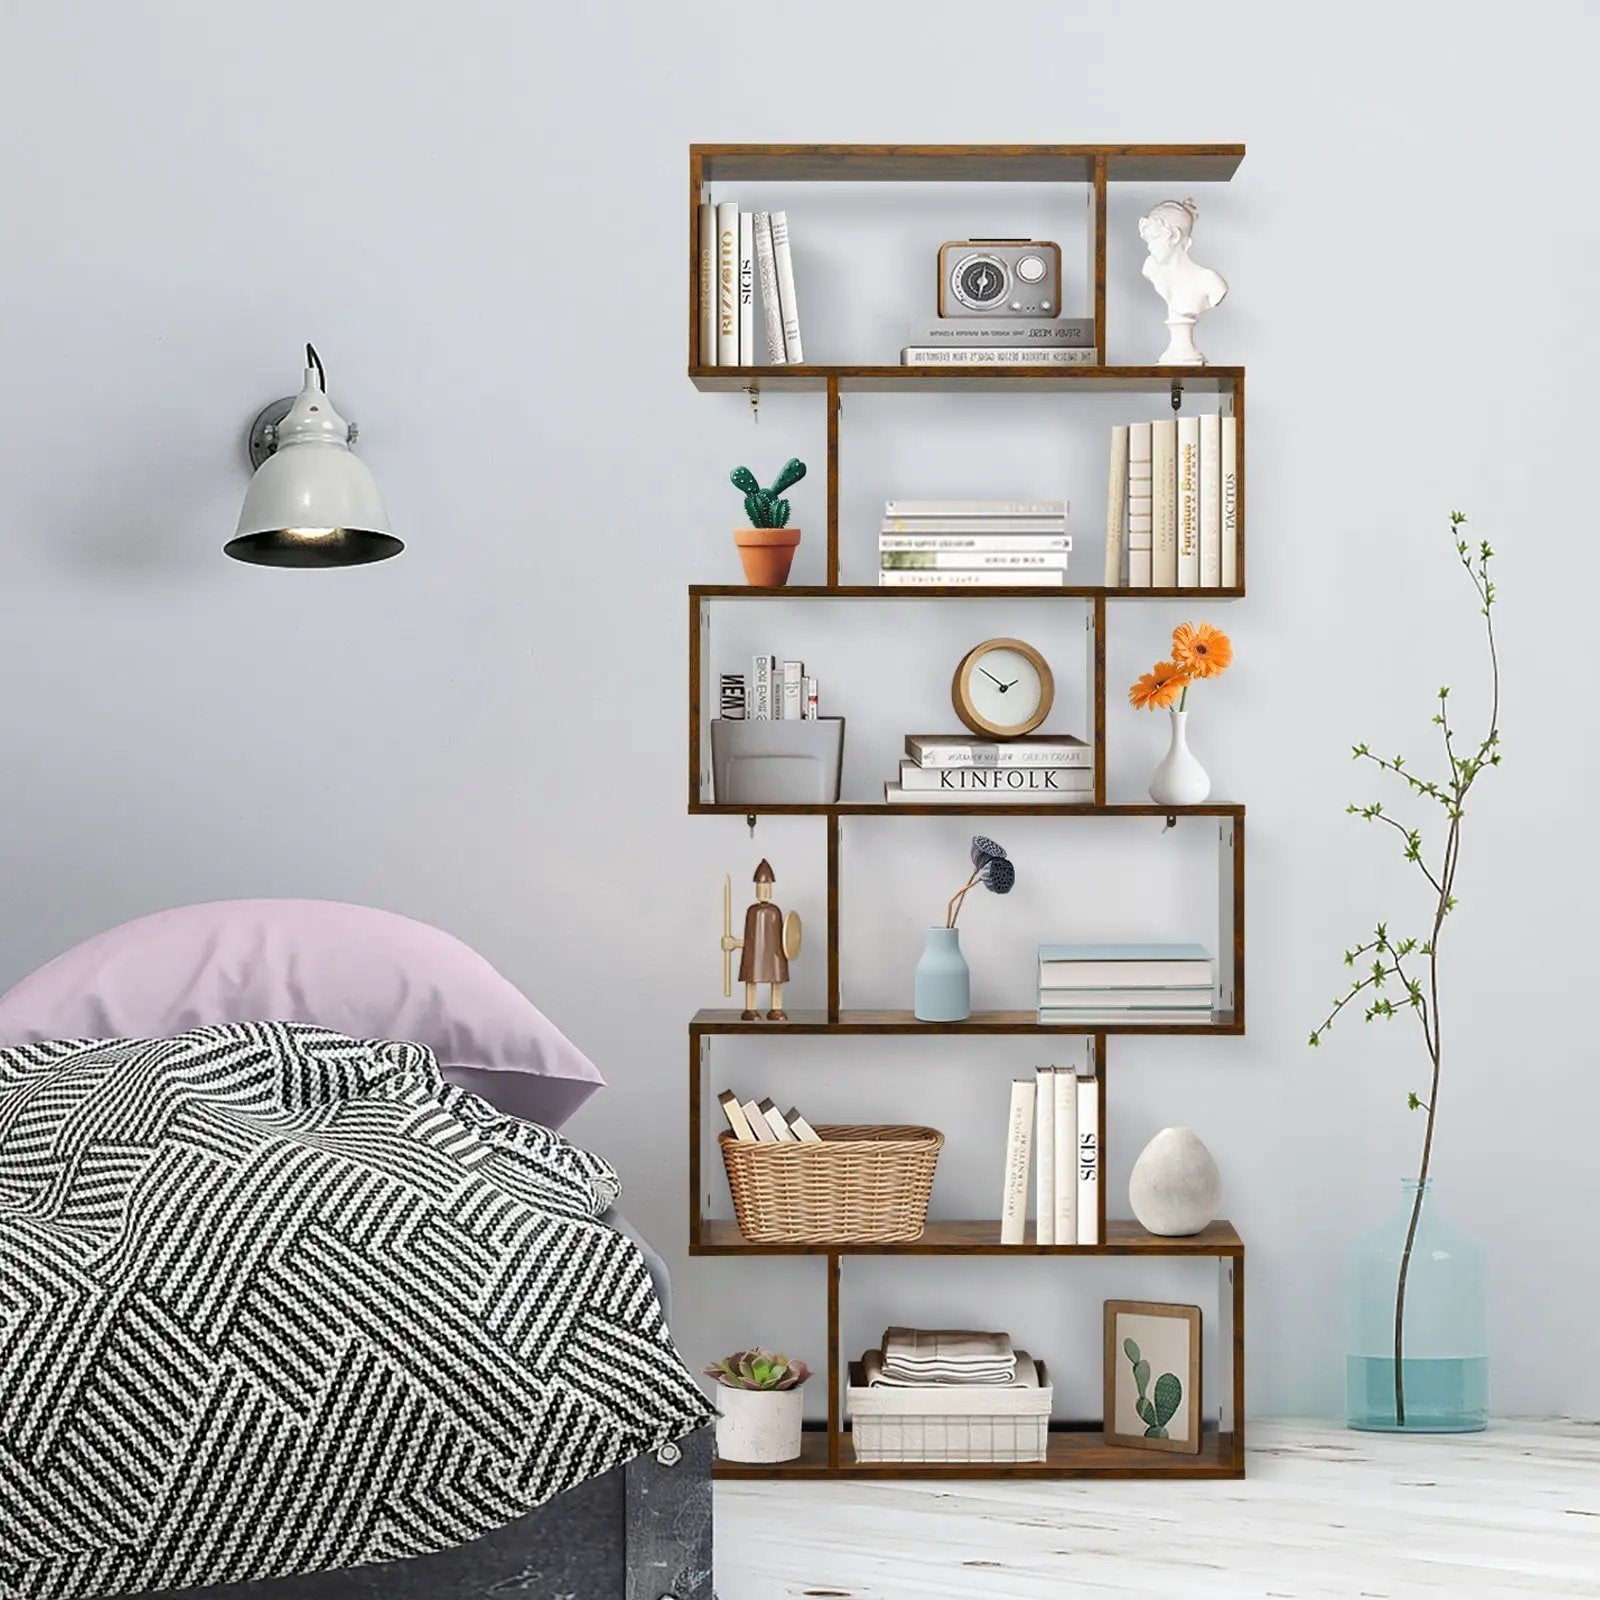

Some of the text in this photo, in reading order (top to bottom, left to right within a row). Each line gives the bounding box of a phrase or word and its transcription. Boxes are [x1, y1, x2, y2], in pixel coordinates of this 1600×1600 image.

[741, 259, 752, 305] SICIS
[1180, 443, 1192, 557] Furniture Brands
[1225, 473, 1236, 532] TACITUS
[940, 770, 1059, 789] KINFOLK
[1017, 1133, 1027, 1194] FURNITURE
[1079, 1133, 1096, 1181] SICIS
